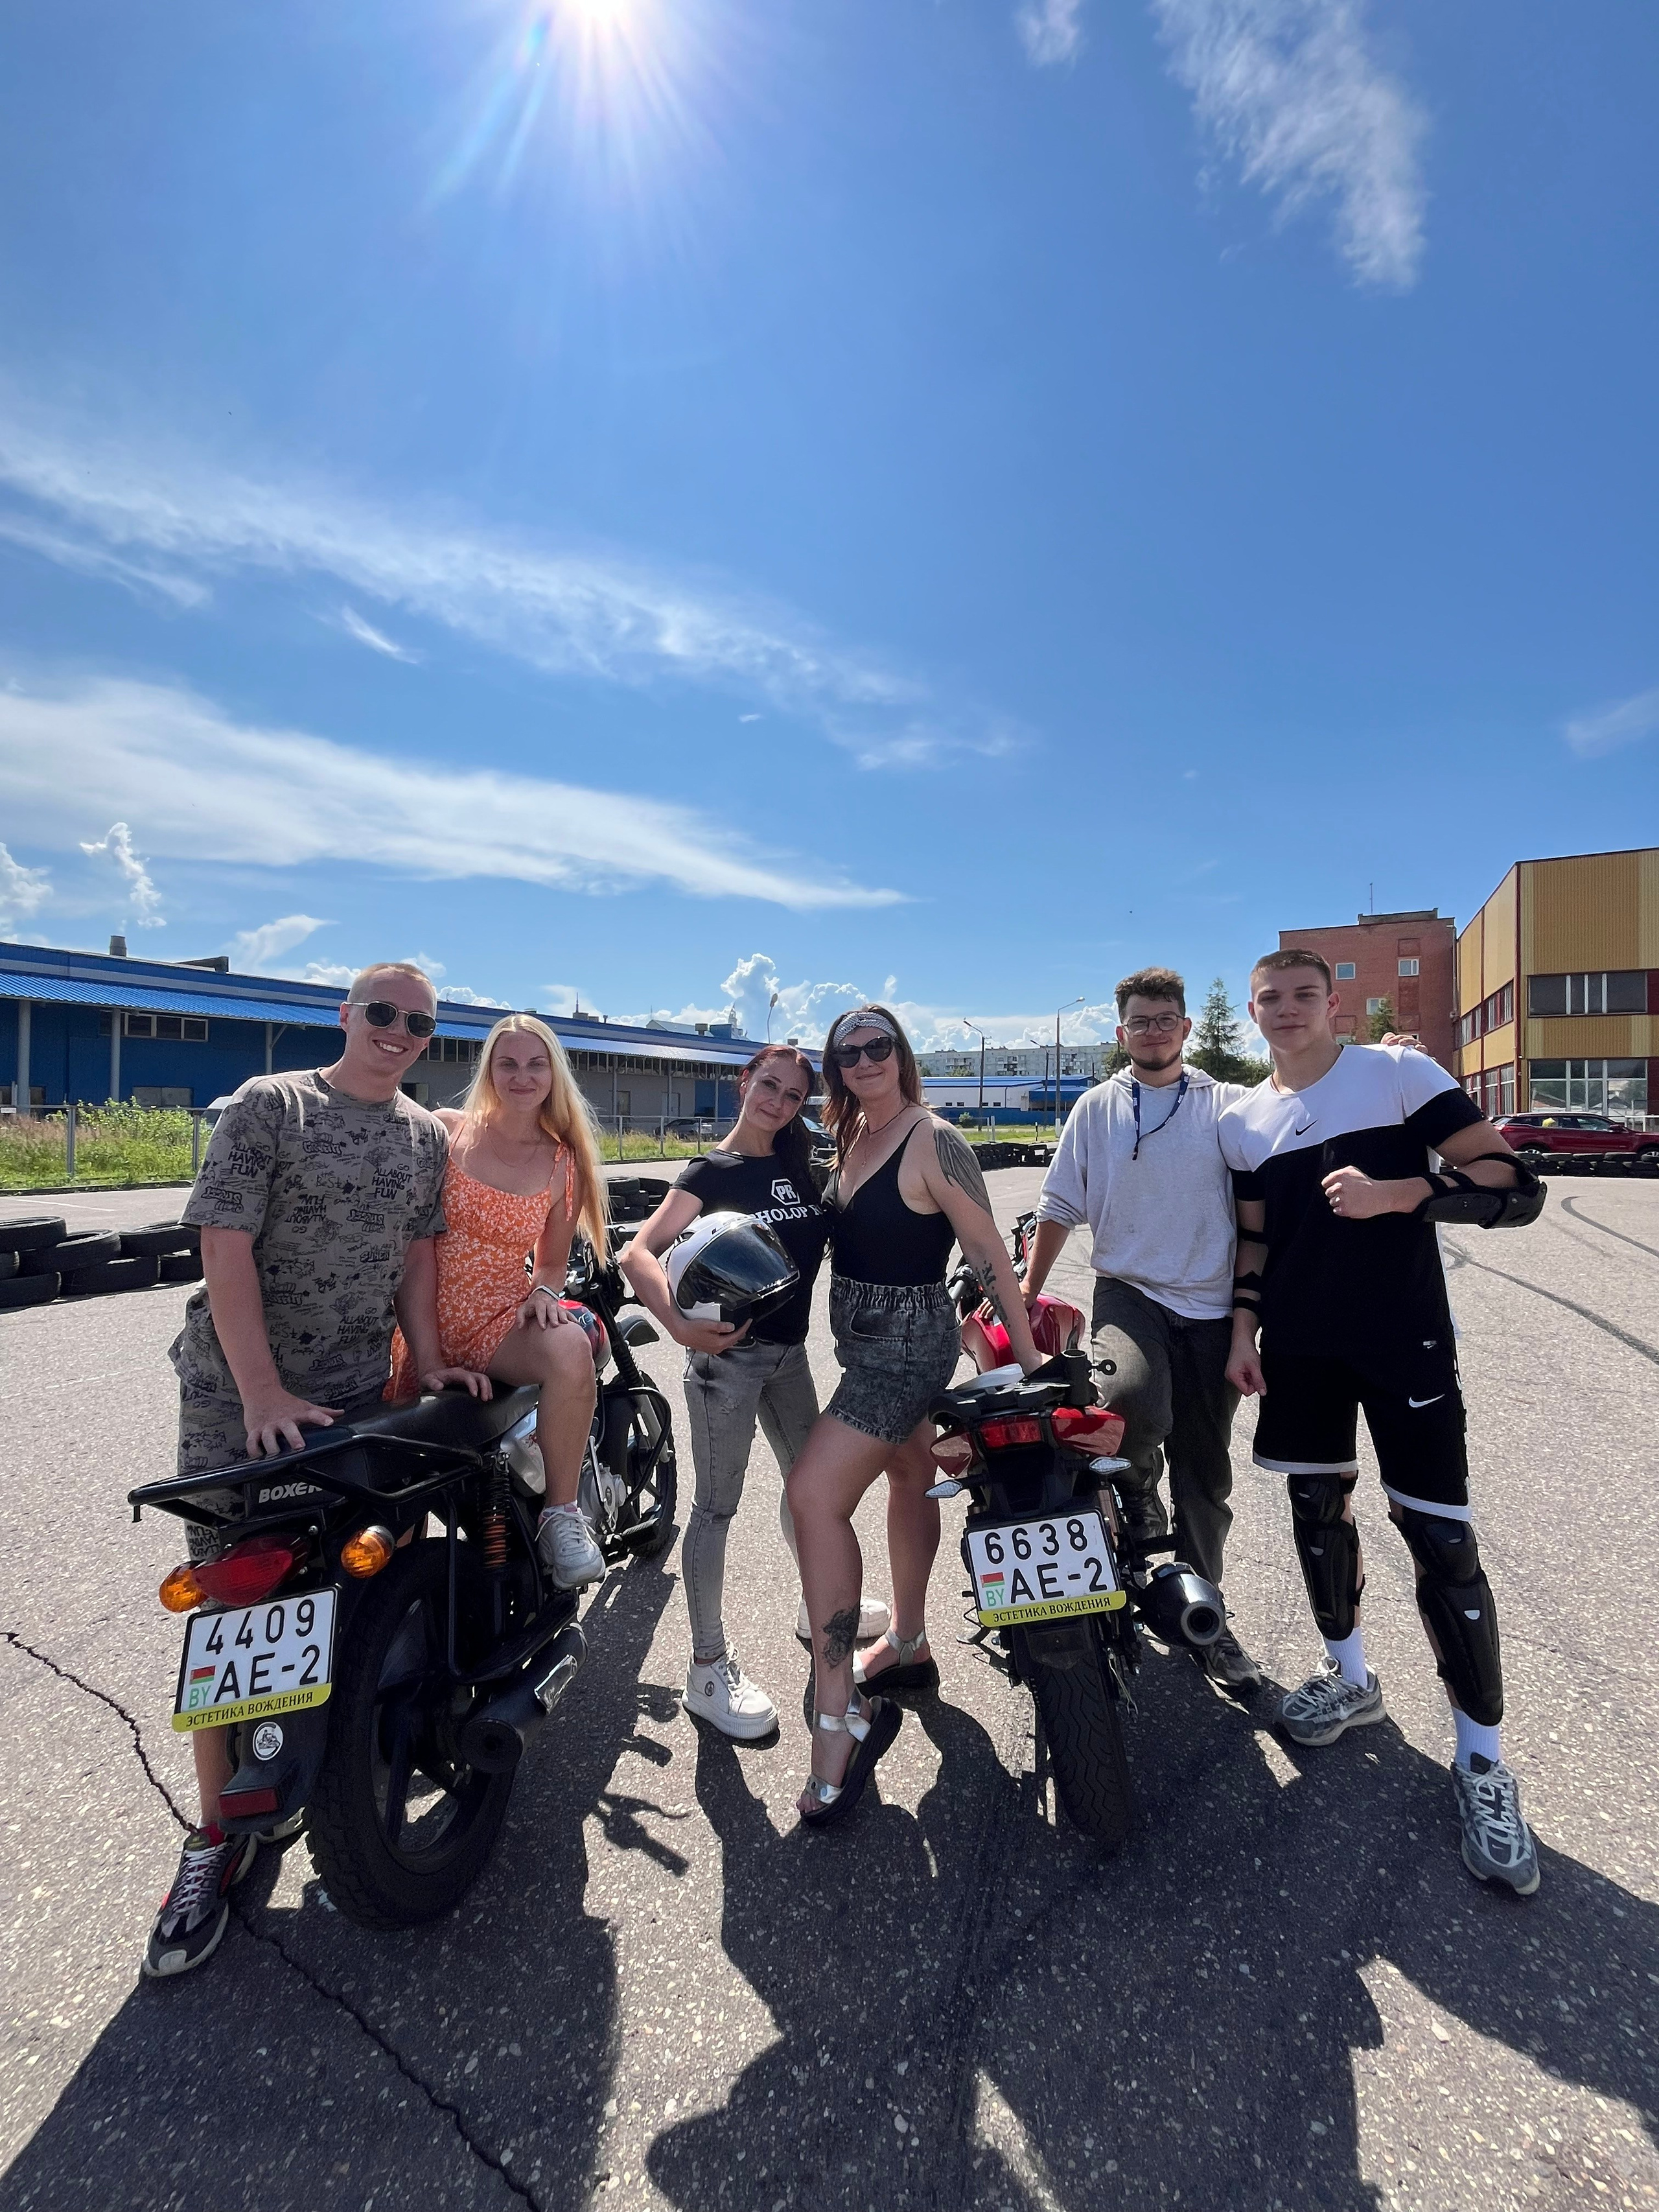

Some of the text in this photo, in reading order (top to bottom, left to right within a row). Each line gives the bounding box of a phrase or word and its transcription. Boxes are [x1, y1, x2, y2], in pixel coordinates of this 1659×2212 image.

[230, 1163, 259, 1178] FUN
[371, 1176, 405, 1190] HAVING
[776, 1185, 796, 1200] PR
[376, 1187, 398, 1200] FUN
[749, 1206, 807, 1224] HOLOP
[337, 1323, 369, 1335] HAVING
[984, 1519, 1088, 1564] 6638
[1010, 1557, 1108, 1604] AE-2
[986, 1589, 1005, 1607] BY
[993, 1597, 1111, 1622] ЭСТЕТИКА ВОЖДЕНИЯ
[205, 1599, 315, 1655] 4409
[213, 1644, 320, 1703] AE-2
[189, 1685, 211, 1708] BY
[186, 1692, 314, 1727] ЭСТЕТИКА ВОЖДЕНИЯ
